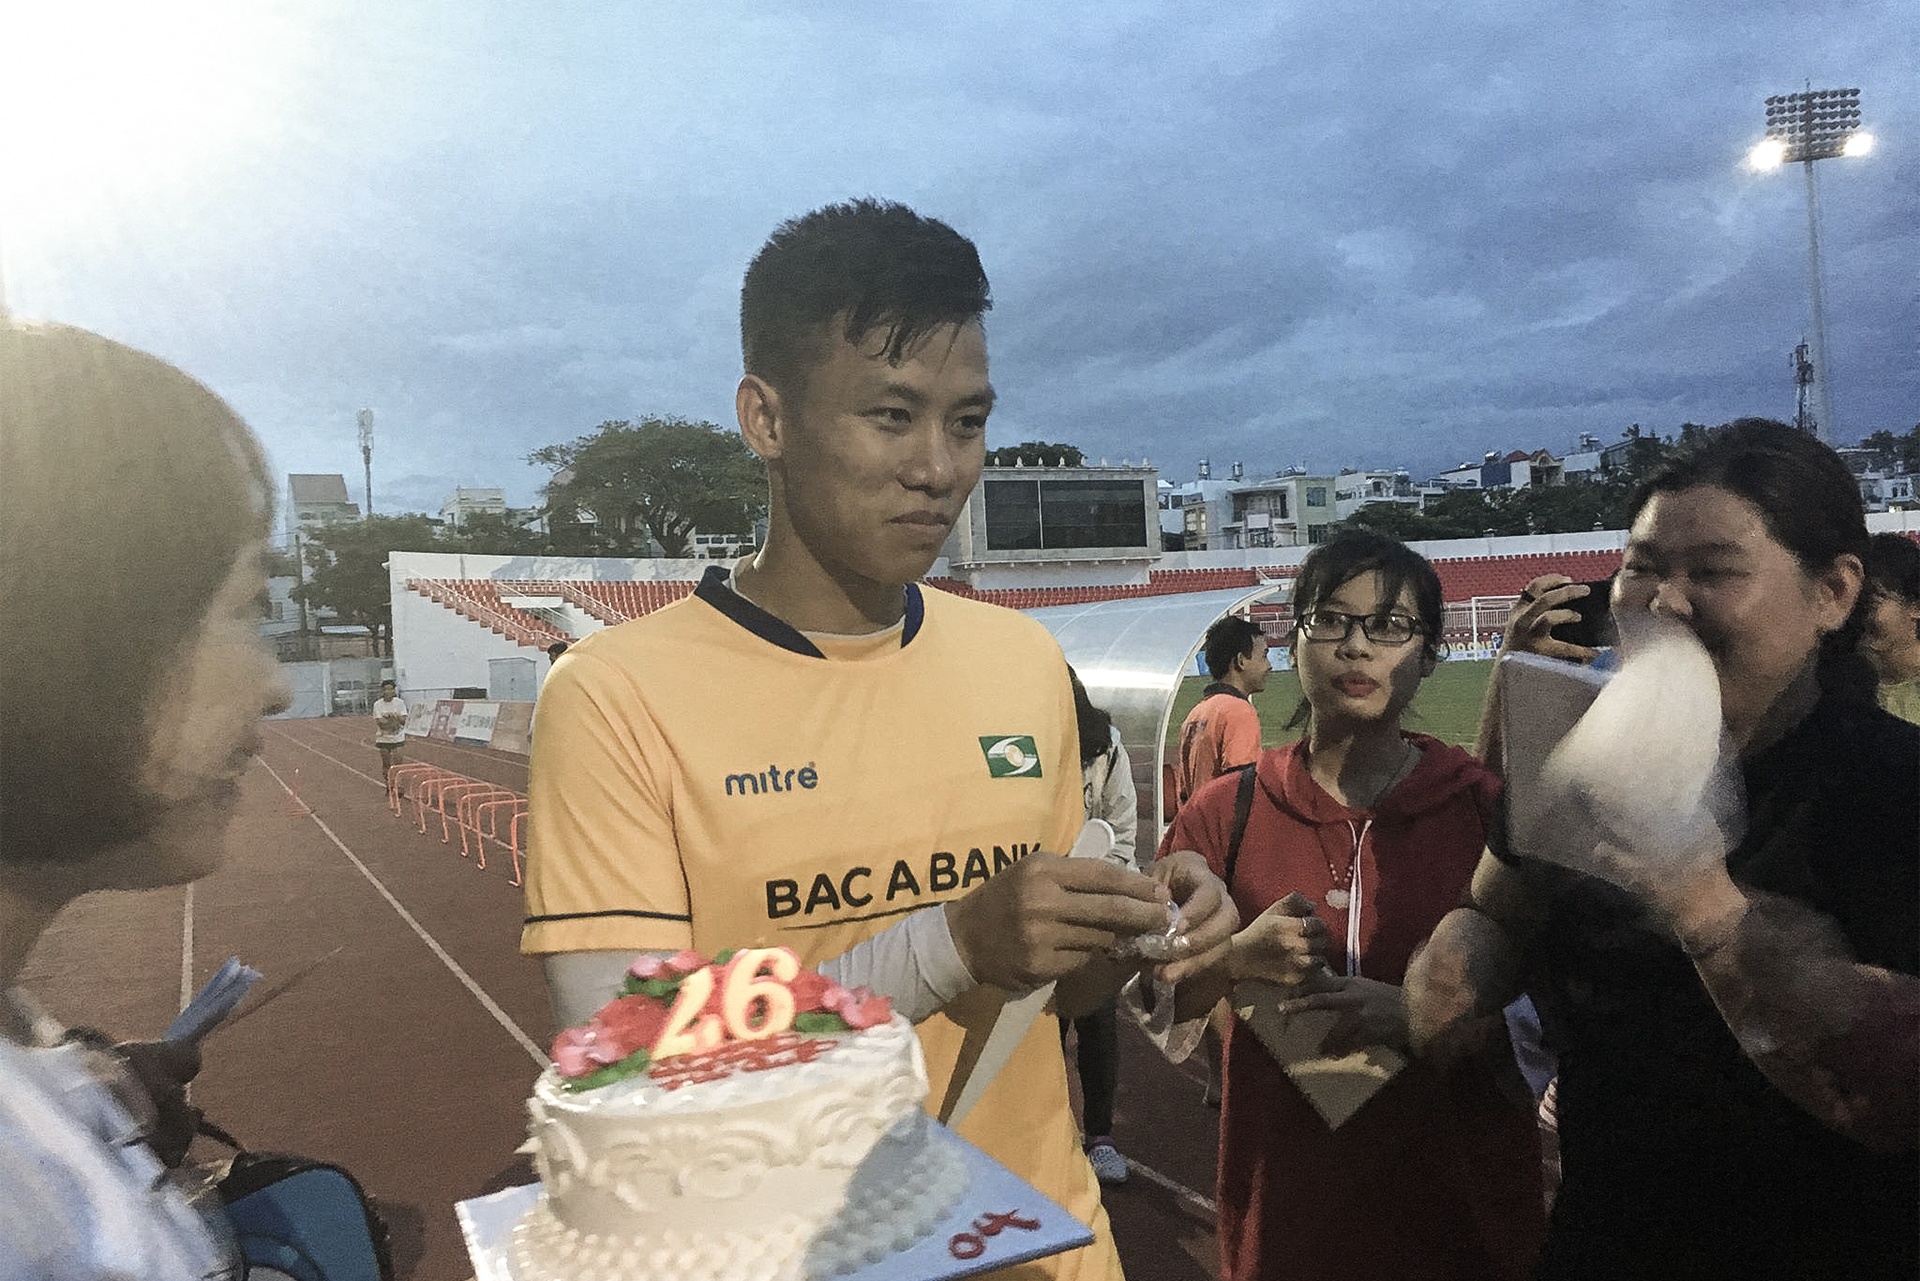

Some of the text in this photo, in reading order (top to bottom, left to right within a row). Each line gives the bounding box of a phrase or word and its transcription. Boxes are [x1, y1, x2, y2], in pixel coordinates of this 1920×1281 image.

[725, 764, 818, 796] mitre
[765, 866, 873, 919] BAC
[885, 859, 921, 901] A
[650, 946, 800, 1061] 26
